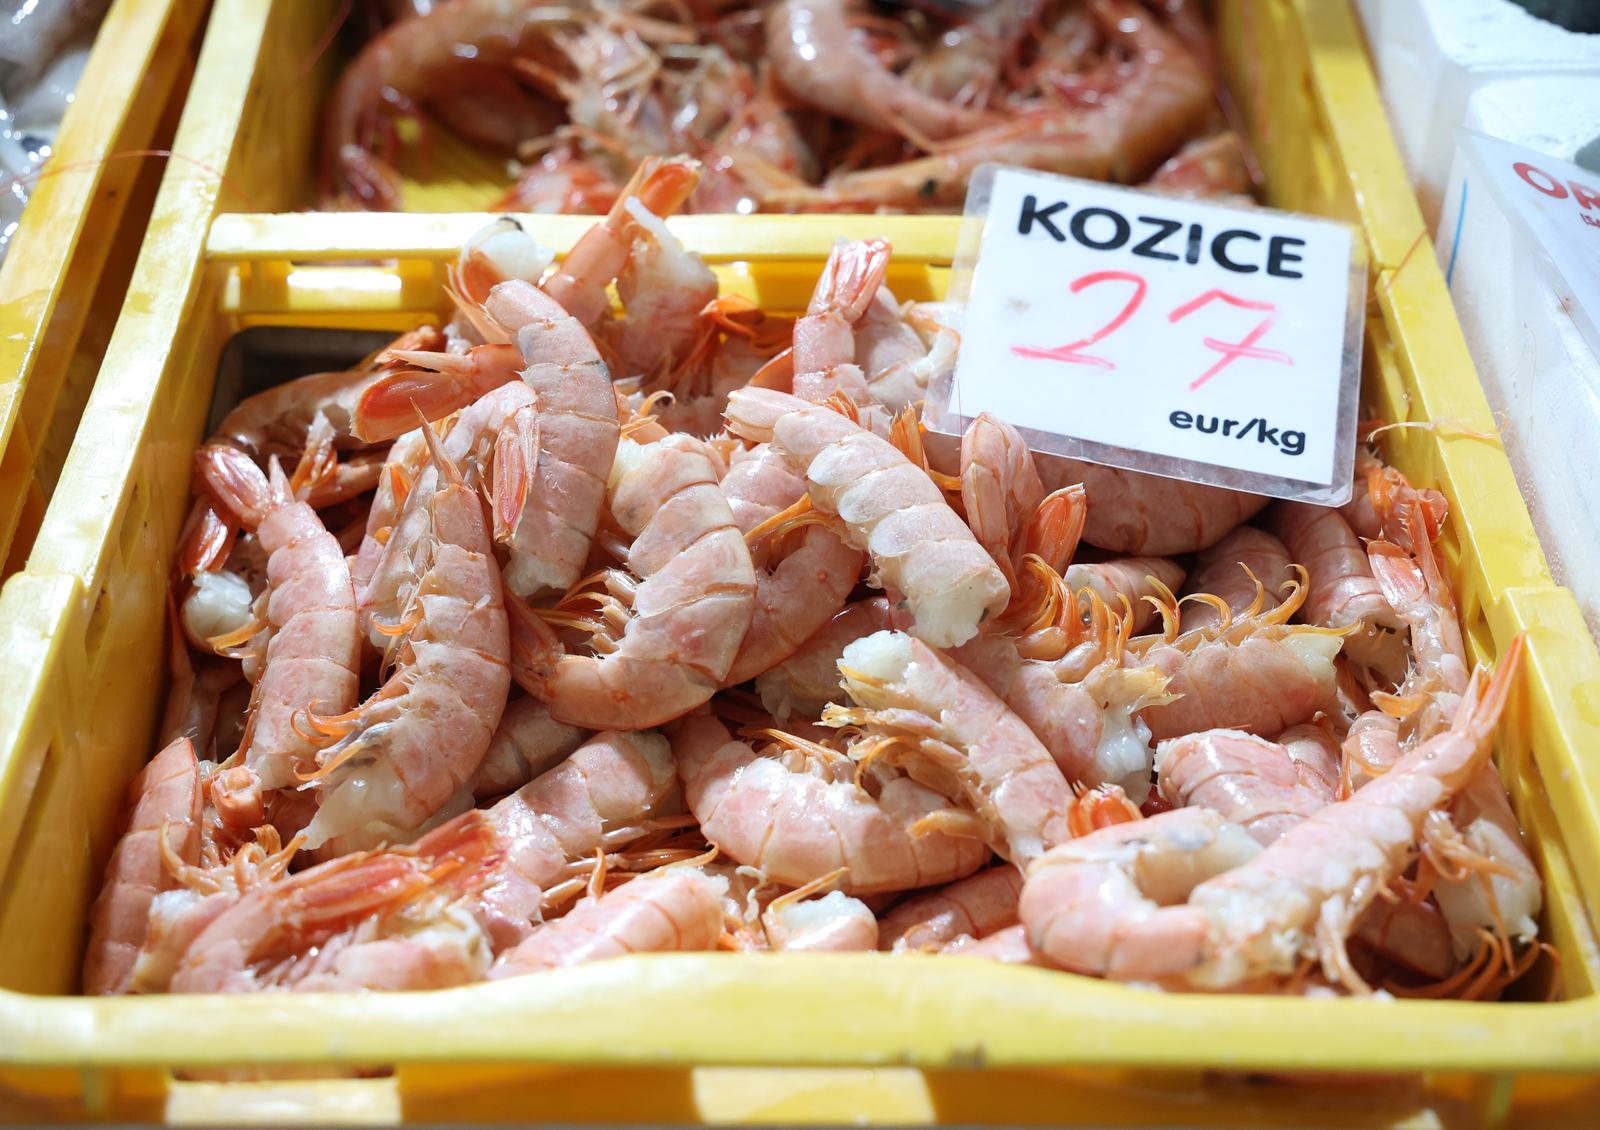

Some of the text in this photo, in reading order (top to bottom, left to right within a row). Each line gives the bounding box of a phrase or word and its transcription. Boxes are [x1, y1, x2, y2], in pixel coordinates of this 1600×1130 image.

[1018, 195, 1306, 279] KOZICE
[1011, 269, 1294, 391] 27
[1169, 410, 1306, 456] eur/kg
